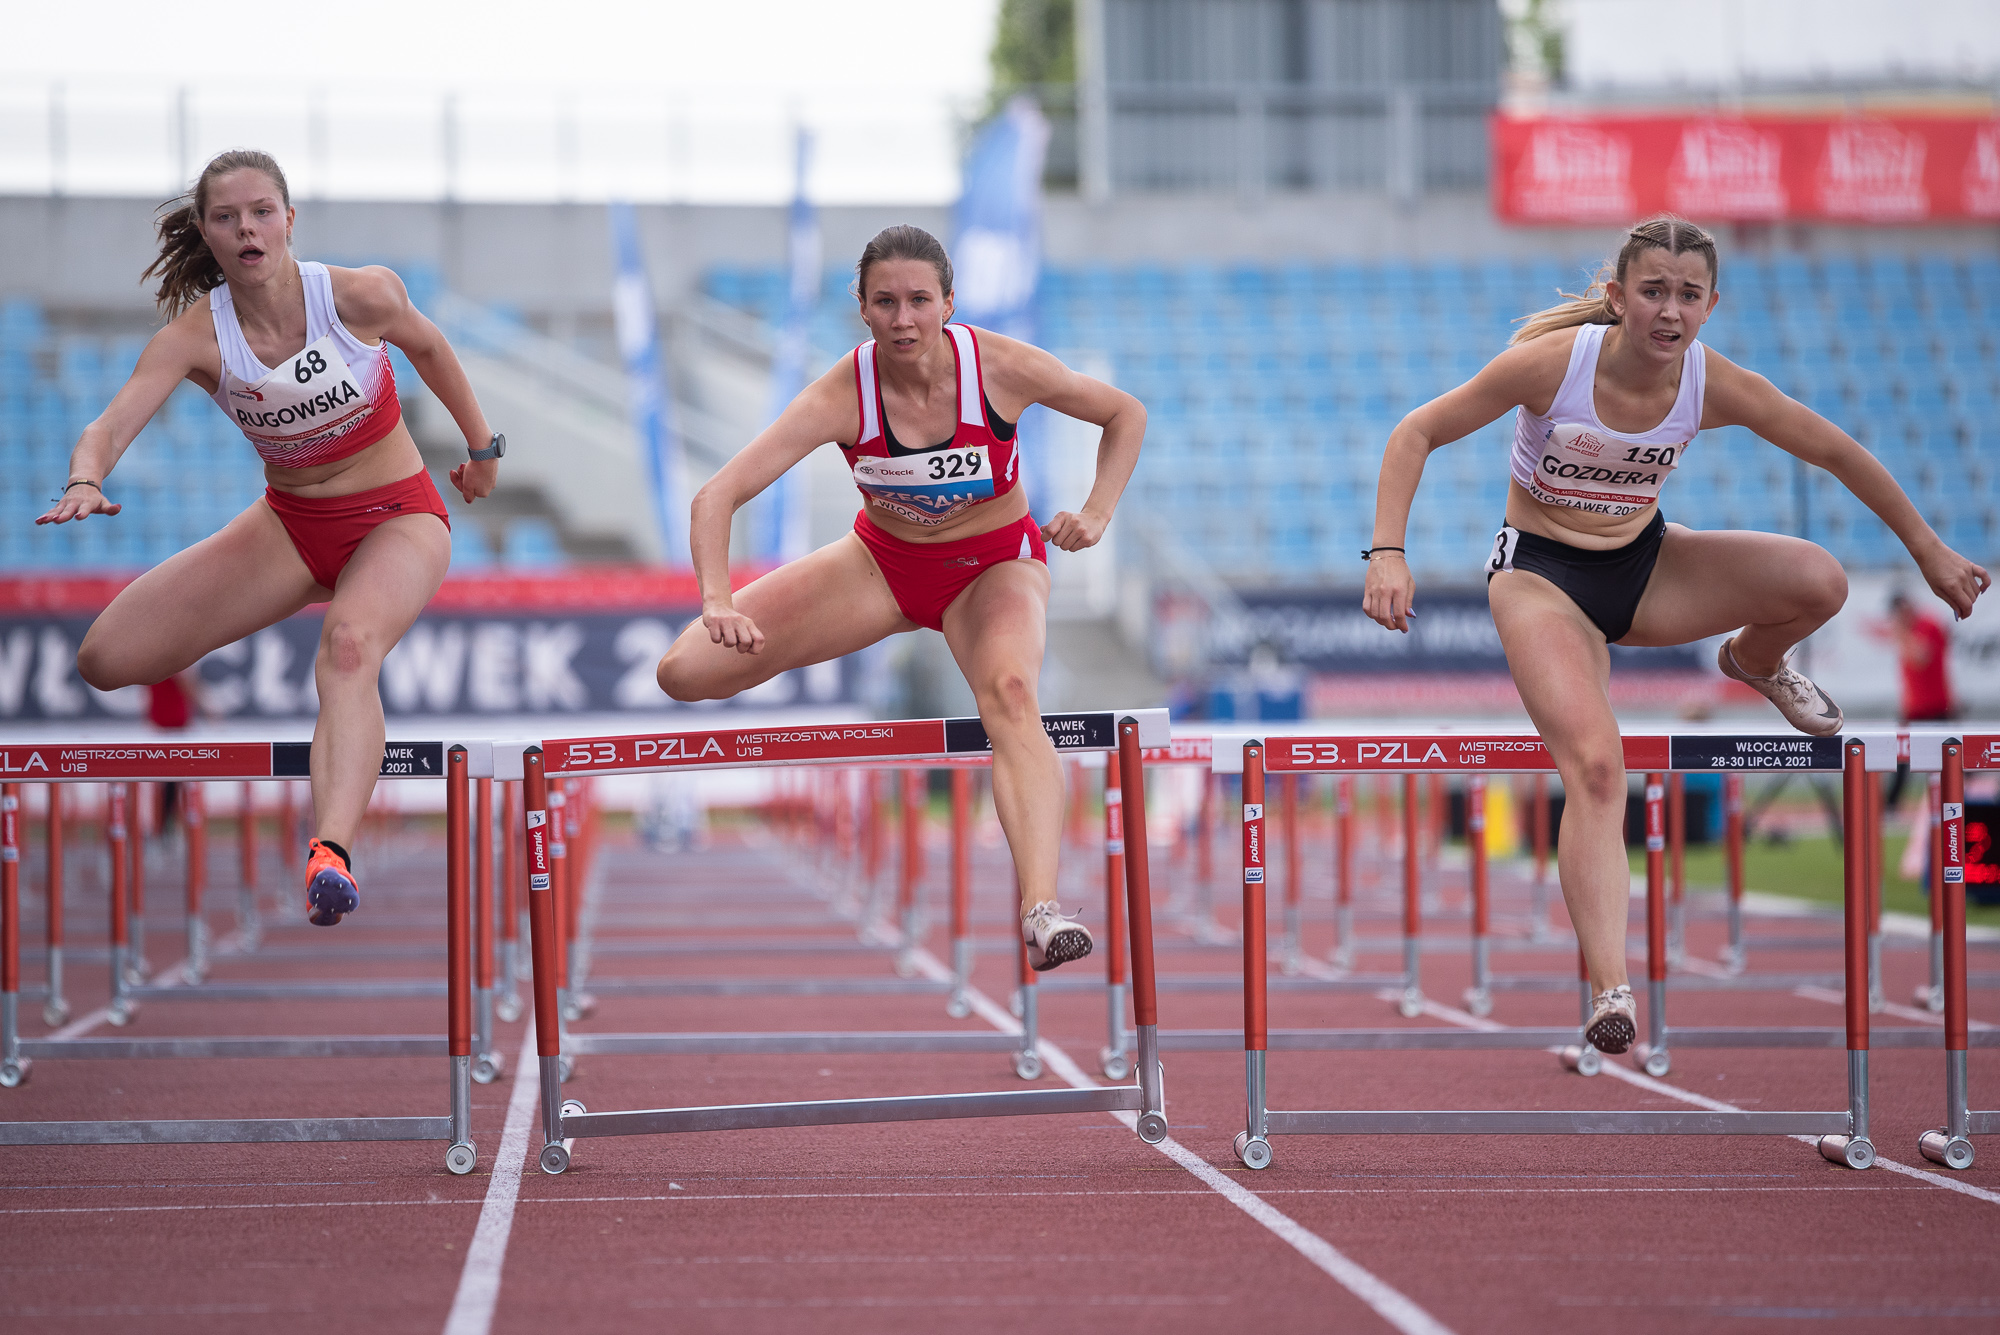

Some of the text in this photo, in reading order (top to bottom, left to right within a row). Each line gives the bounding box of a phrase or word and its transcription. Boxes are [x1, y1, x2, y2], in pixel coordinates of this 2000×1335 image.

[294, 349, 328, 384] 68
[235, 379, 360, 429] RUGOWSKA
[1567, 432, 1606, 453] Anwil
[927, 451, 982, 480] 329
[1622, 446, 1676, 466] 150
[1542, 454, 1658, 485] GOZDERA
[1529, 481, 1612, 515] WŁOCŁAWEK
[1560, 489, 1611, 500] MISTRZOSTWA
[1610, 494, 1636, 503] POLSKI
[1491, 530, 1508, 570] 3
[735, 728, 894, 745] MISTRZOSTWA POLSKI
[1058, 734, 1086, 746] 2021
[1458, 741, 1549, 752] MISTRZOST
[1735, 741, 1813, 753] WŁOCŁAWEK
[0, 751, 50, 772] LA
[60, 748, 220, 760] MISTRZOSTWA POLSKI
[568, 736, 726, 766] 53. PZLA
[735, 746, 764, 758] U18
[1291, 742, 1448, 765] 53. PZLA
[1458, 754, 1486, 765] U18
[1711, 756, 1812, 767] 28-30 LIPCA 2021
[60, 762, 88, 773] U18
[386, 762, 413, 773] 2021
[533, 831, 546, 870] polanik
[1248, 824, 1261, 864] polanik
[1947, 824, 1960, 863] polanik
